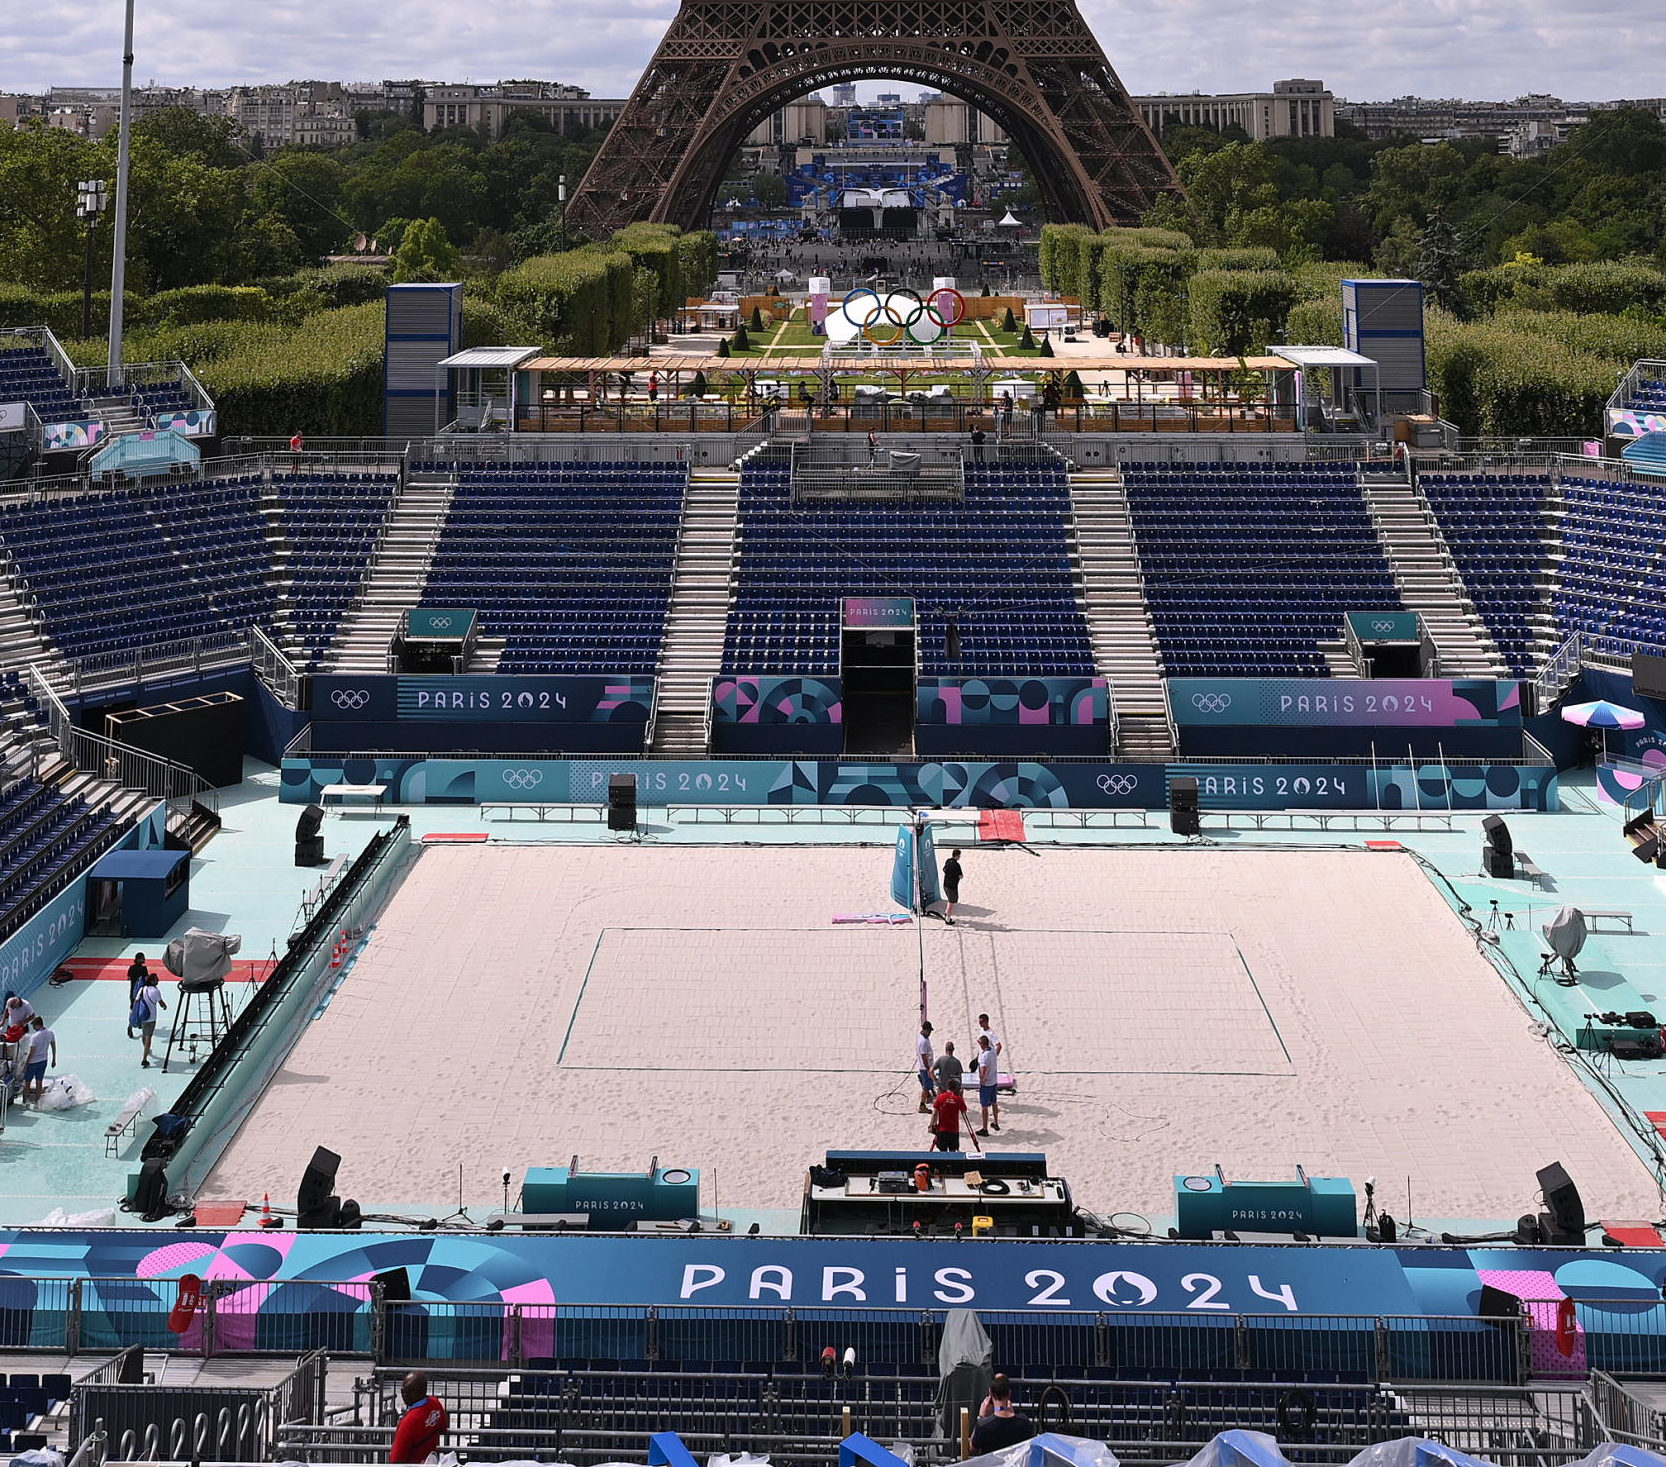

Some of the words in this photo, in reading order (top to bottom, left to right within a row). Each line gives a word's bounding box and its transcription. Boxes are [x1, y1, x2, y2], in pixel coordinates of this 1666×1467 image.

[850, 608, 878, 616] PARIS
[881, 608, 907, 616] 2024
[418, 692, 490, 709] PARIS
[501, 692, 566, 709] 2024
[1281, 695, 1355, 713] PARIS
[1365, 695, 1432, 713] 2024
[678, 773, 746, 791] 2024
[1190, 777, 1264, 795] ARIS
[1276, 777, 1346, 795] 2024
[575, 1200, 609, 1210] PARIS
[613, 1200, 644, 1210] 2024
[1232, 1210, 1267, 1220] PARIS
[1270, 1210, 1302, 1220] 2024
[679, 1264, 976, 1302] PARIS
[1025, 1269, 1298, 1311] 2024
